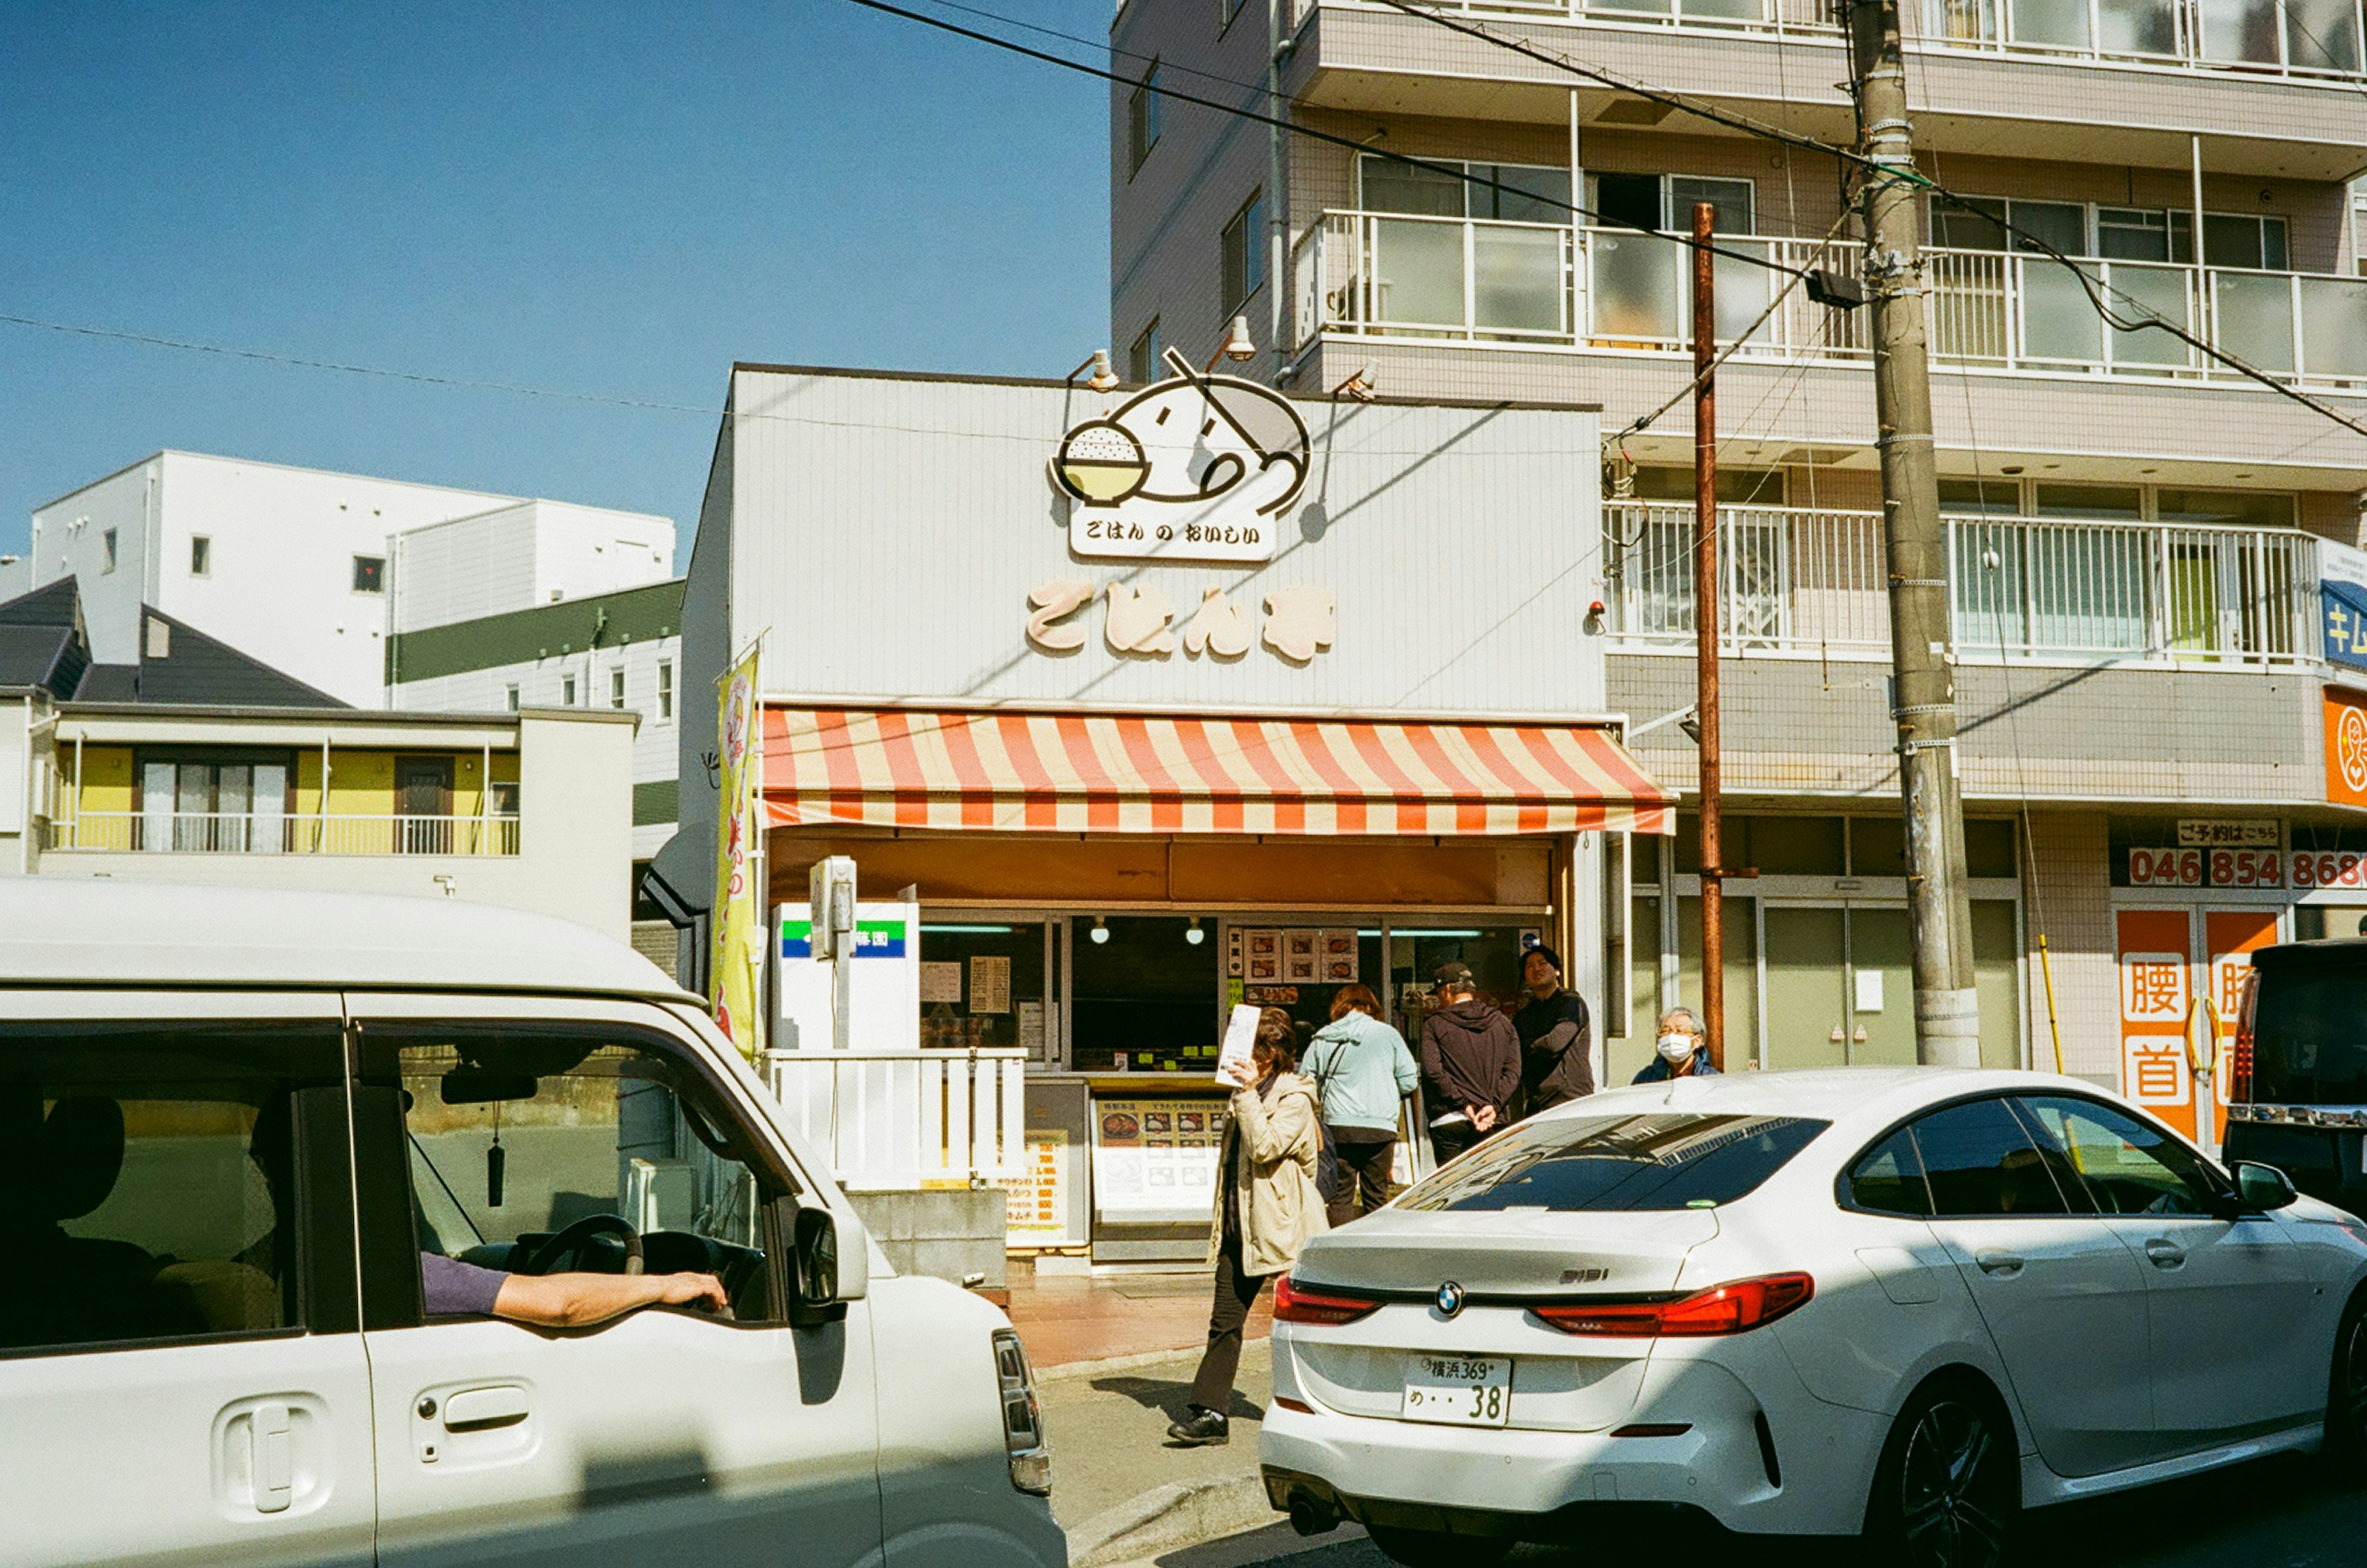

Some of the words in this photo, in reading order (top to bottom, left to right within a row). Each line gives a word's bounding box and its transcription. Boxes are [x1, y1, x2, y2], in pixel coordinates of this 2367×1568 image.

[1086, 521, 1144, 540] ごはん
[1155, 524, 1173, 541] の
[1185, 523, 1260, 544] おいしい
[2180, 824, 2277, 842] ご予約はこちら
[2131, 851, 2201, 884] 046
[2212, 853, 2279, 885] 854
[2293, 854, 2367, 886] 868
[2131, 961, 2179, 1013] 腰
[2132, 1044, 2180, 1097] 首
